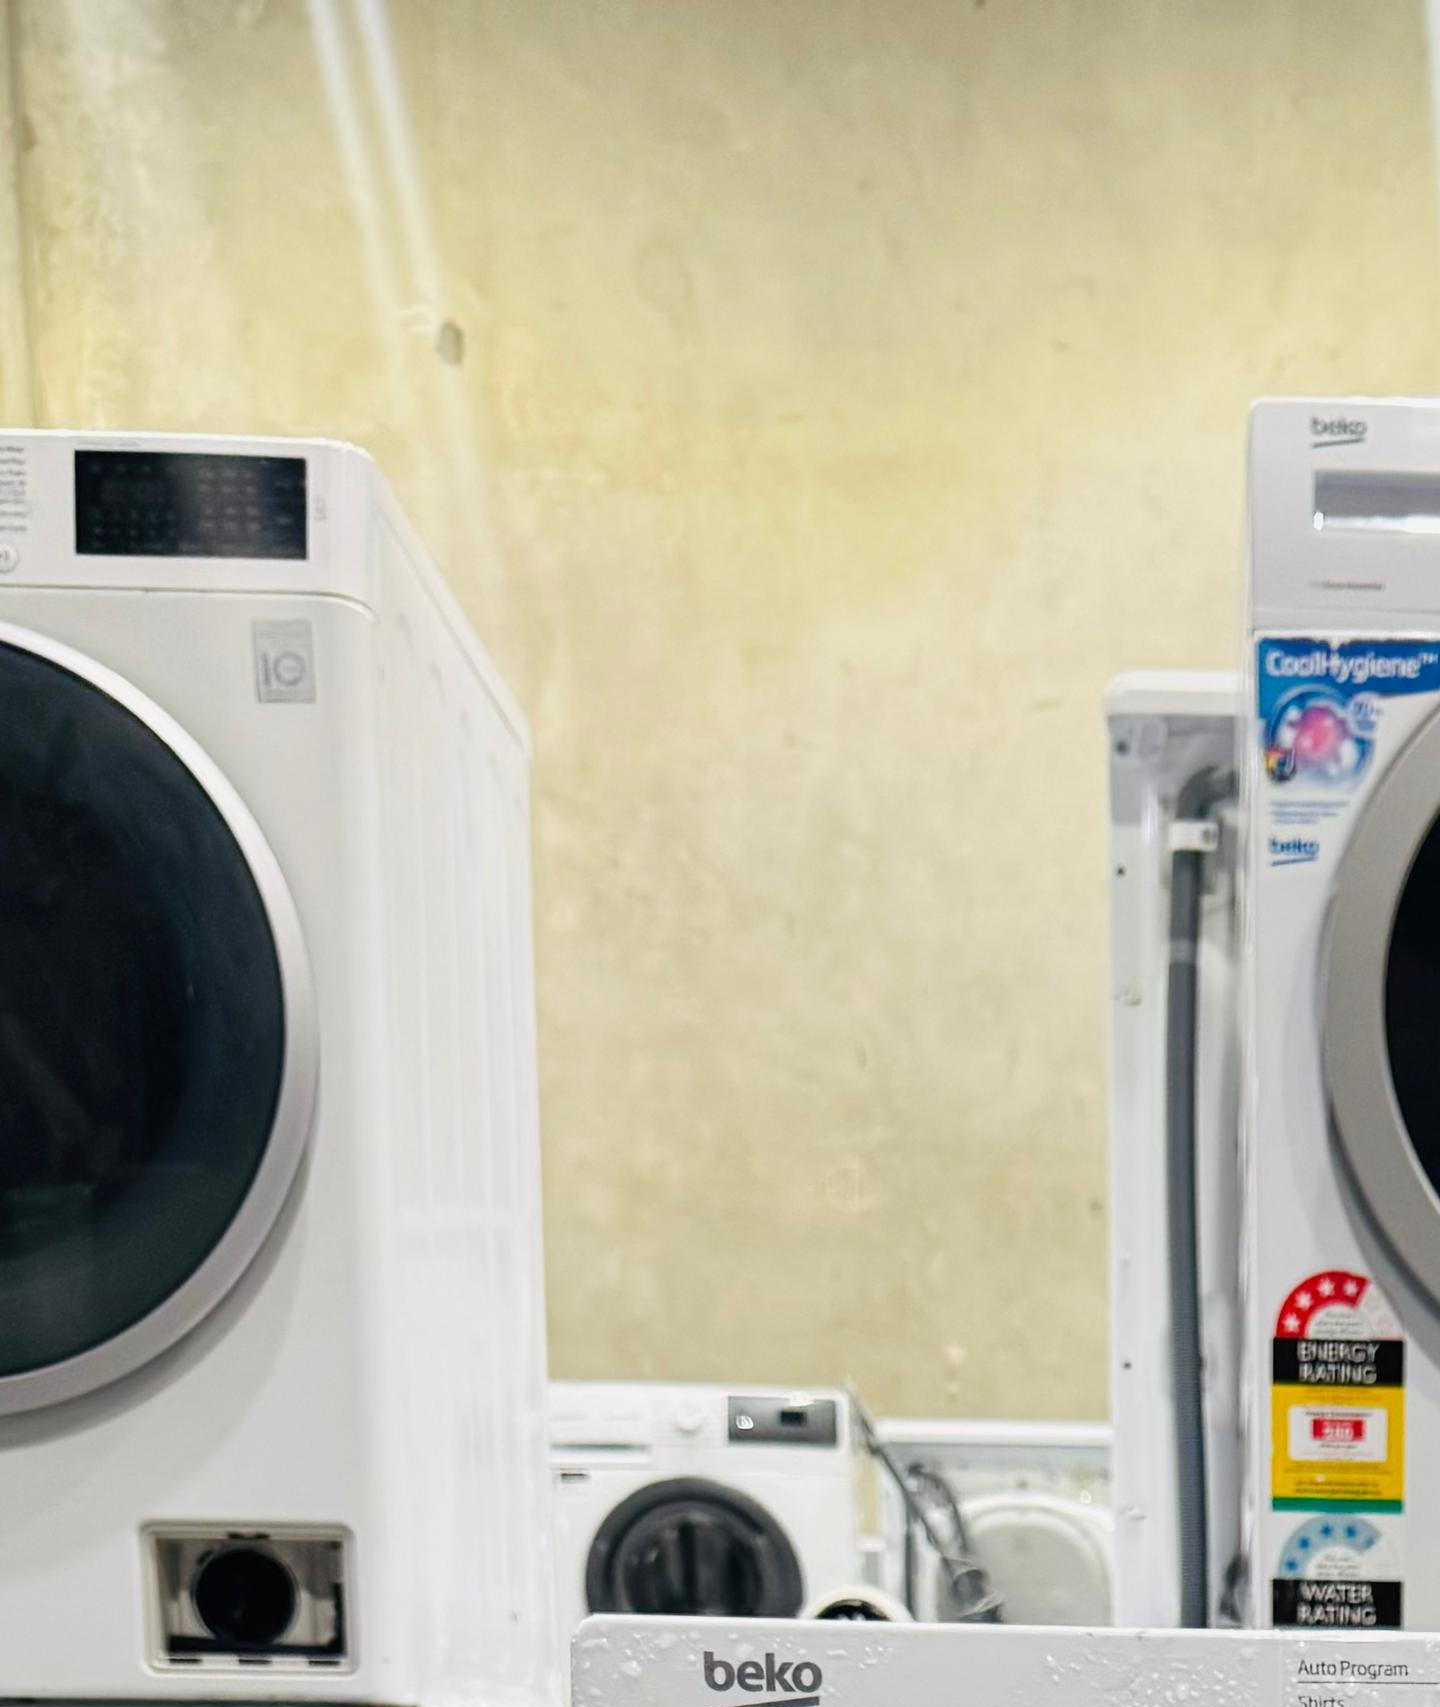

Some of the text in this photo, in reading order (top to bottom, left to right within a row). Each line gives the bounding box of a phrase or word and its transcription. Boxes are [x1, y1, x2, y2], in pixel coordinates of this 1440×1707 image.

[1311, 416, 1367, 437] beko
[1297, 1341, 1380, 1363] ENERGY
[1298, 1362, 1377, 1384] RATING
[1300, 1583, 1374, 1604] WATER
[1297, 1603, 1377, 1625] RATING
[704, 1651, 823, 1693] beko
[1298, 1660, 1408, 1680] Auto Program
